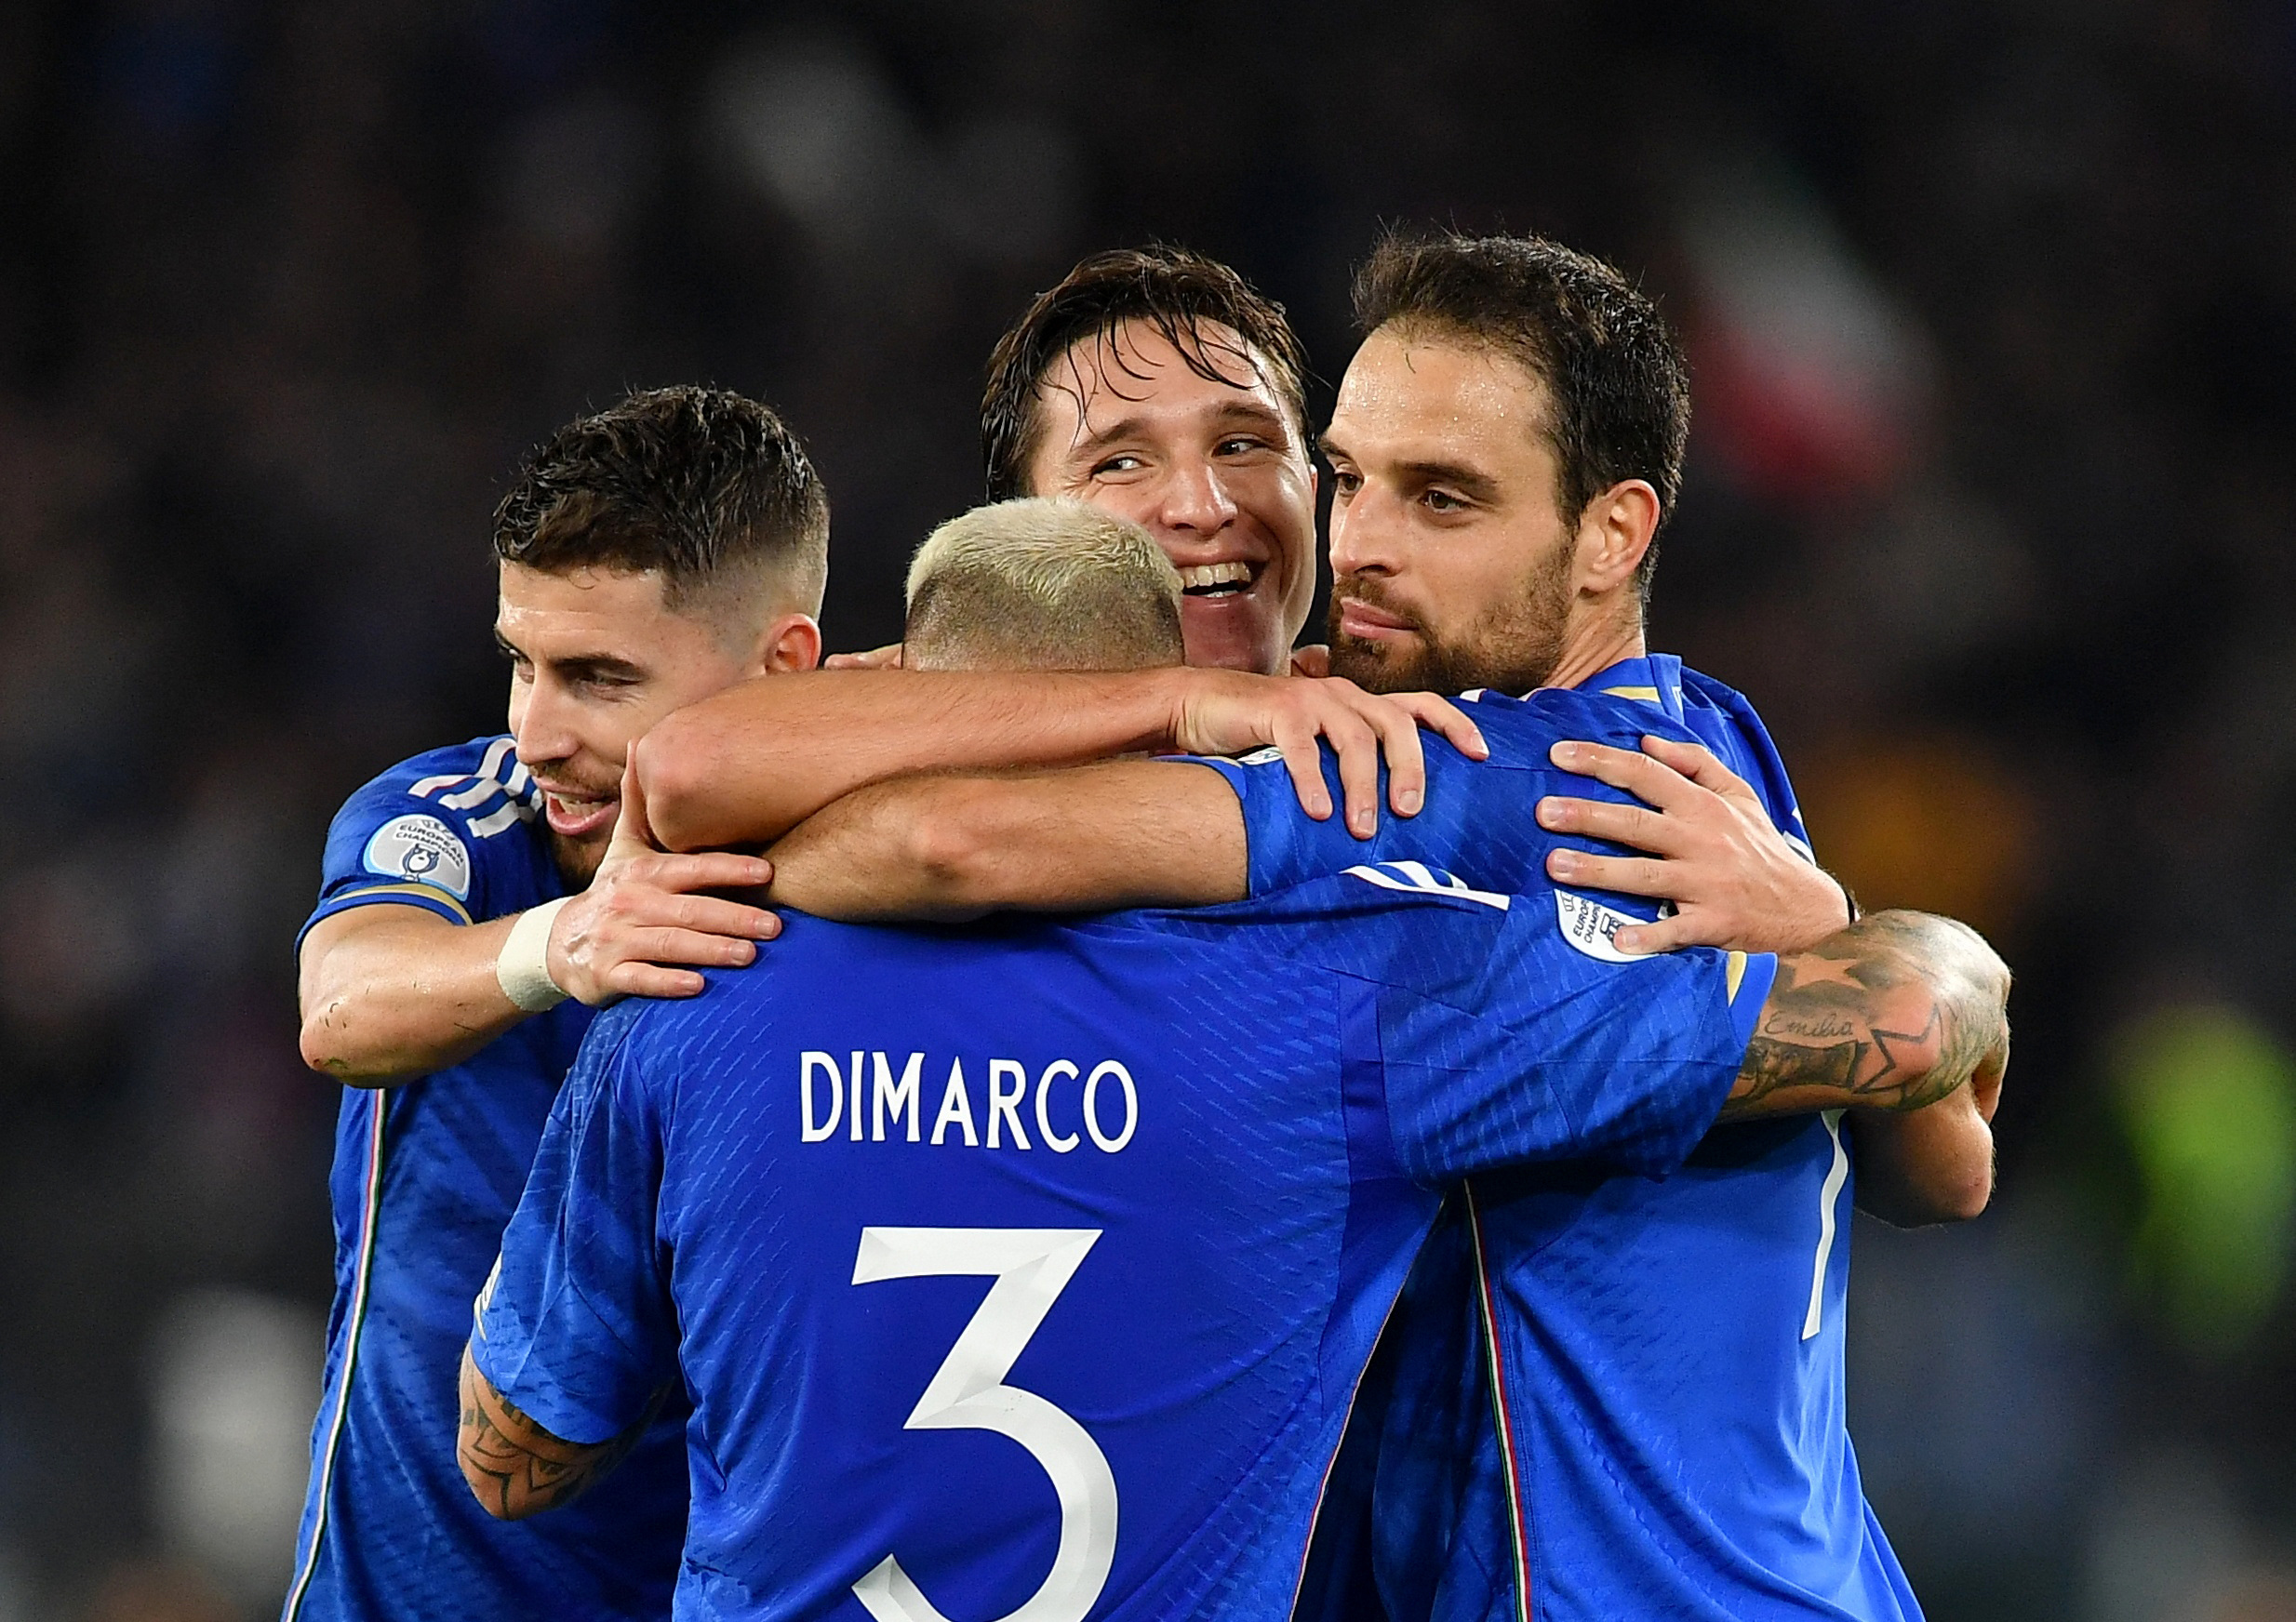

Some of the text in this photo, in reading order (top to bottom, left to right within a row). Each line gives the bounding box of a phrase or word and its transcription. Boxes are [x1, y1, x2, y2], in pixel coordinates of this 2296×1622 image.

[395, 831, 461, 868] CHAMPIONS
[399, 824, 464, 863] EUROPEAN
[800, 1050, 1140, 1154] DIMARCO
[850, 1226, 1119, 1622] 3
